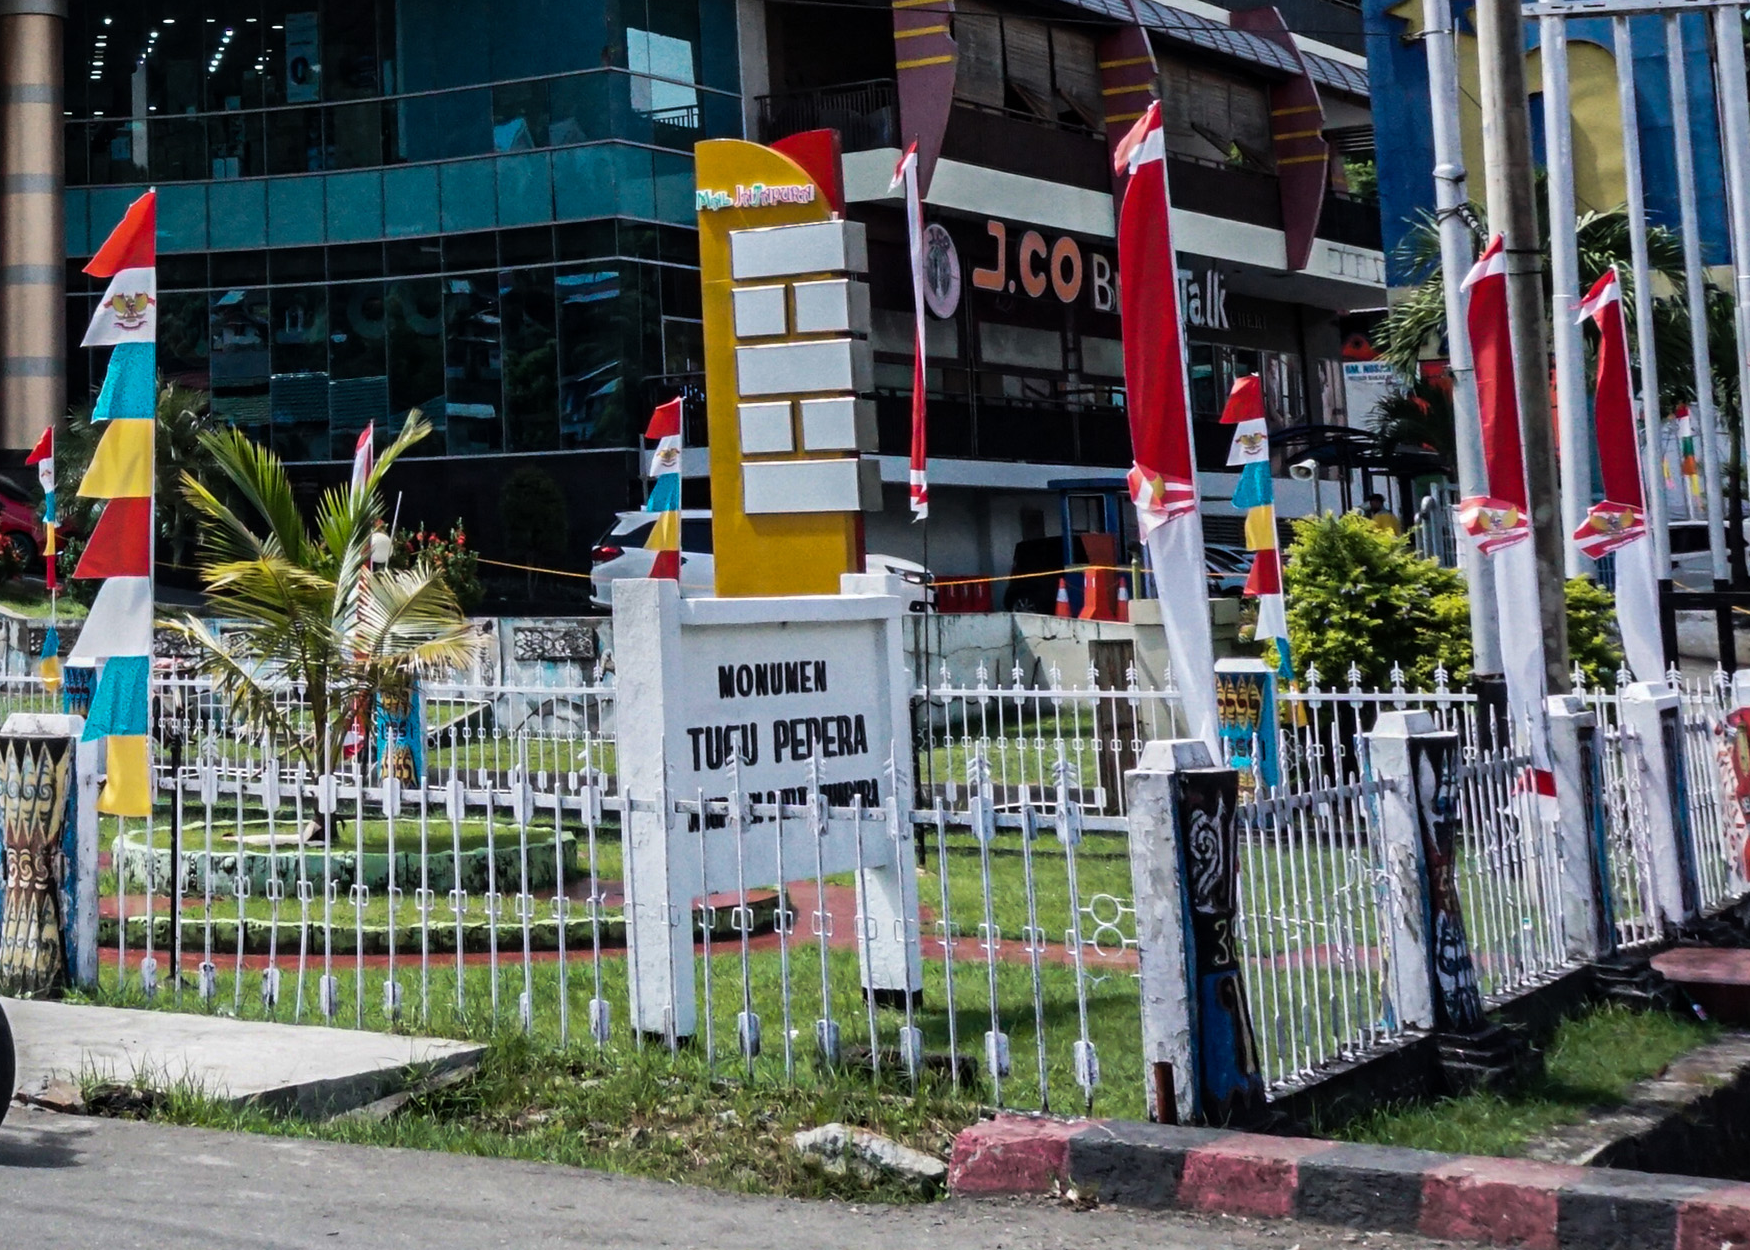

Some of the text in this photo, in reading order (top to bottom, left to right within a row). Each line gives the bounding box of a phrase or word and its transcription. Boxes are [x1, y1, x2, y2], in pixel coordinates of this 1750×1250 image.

[972, 220, 1083, 303] J.CO
[717, 659, 828, 700] MONUMEN
[772, 713, 869, 764] PEPERA
